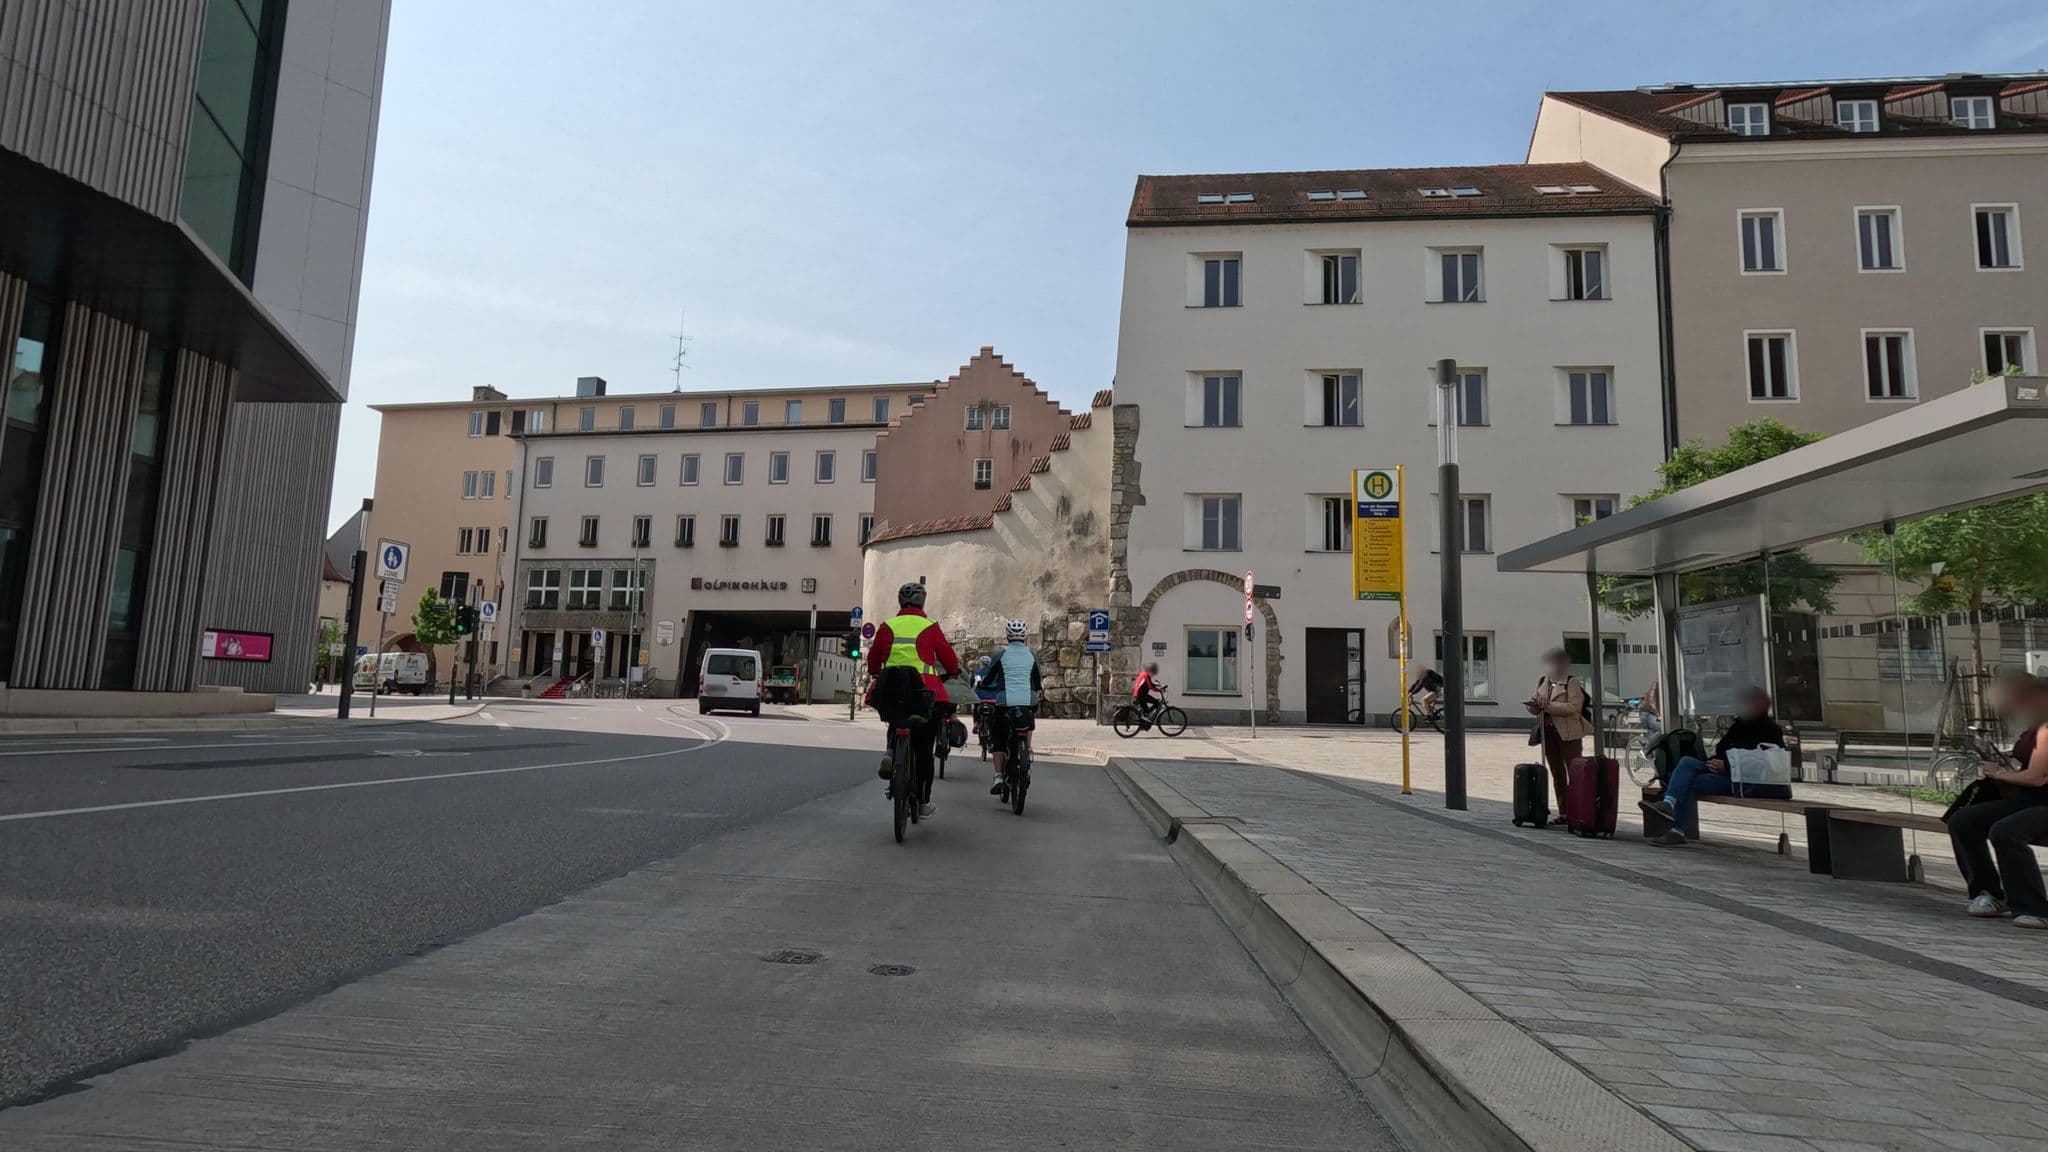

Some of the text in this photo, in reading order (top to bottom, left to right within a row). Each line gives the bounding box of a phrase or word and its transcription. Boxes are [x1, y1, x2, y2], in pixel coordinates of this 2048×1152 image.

[1372, 478, 1384, 493] H
[384, 569, 397, 577] ZONE
[1096, 617, 1104, 629] P
